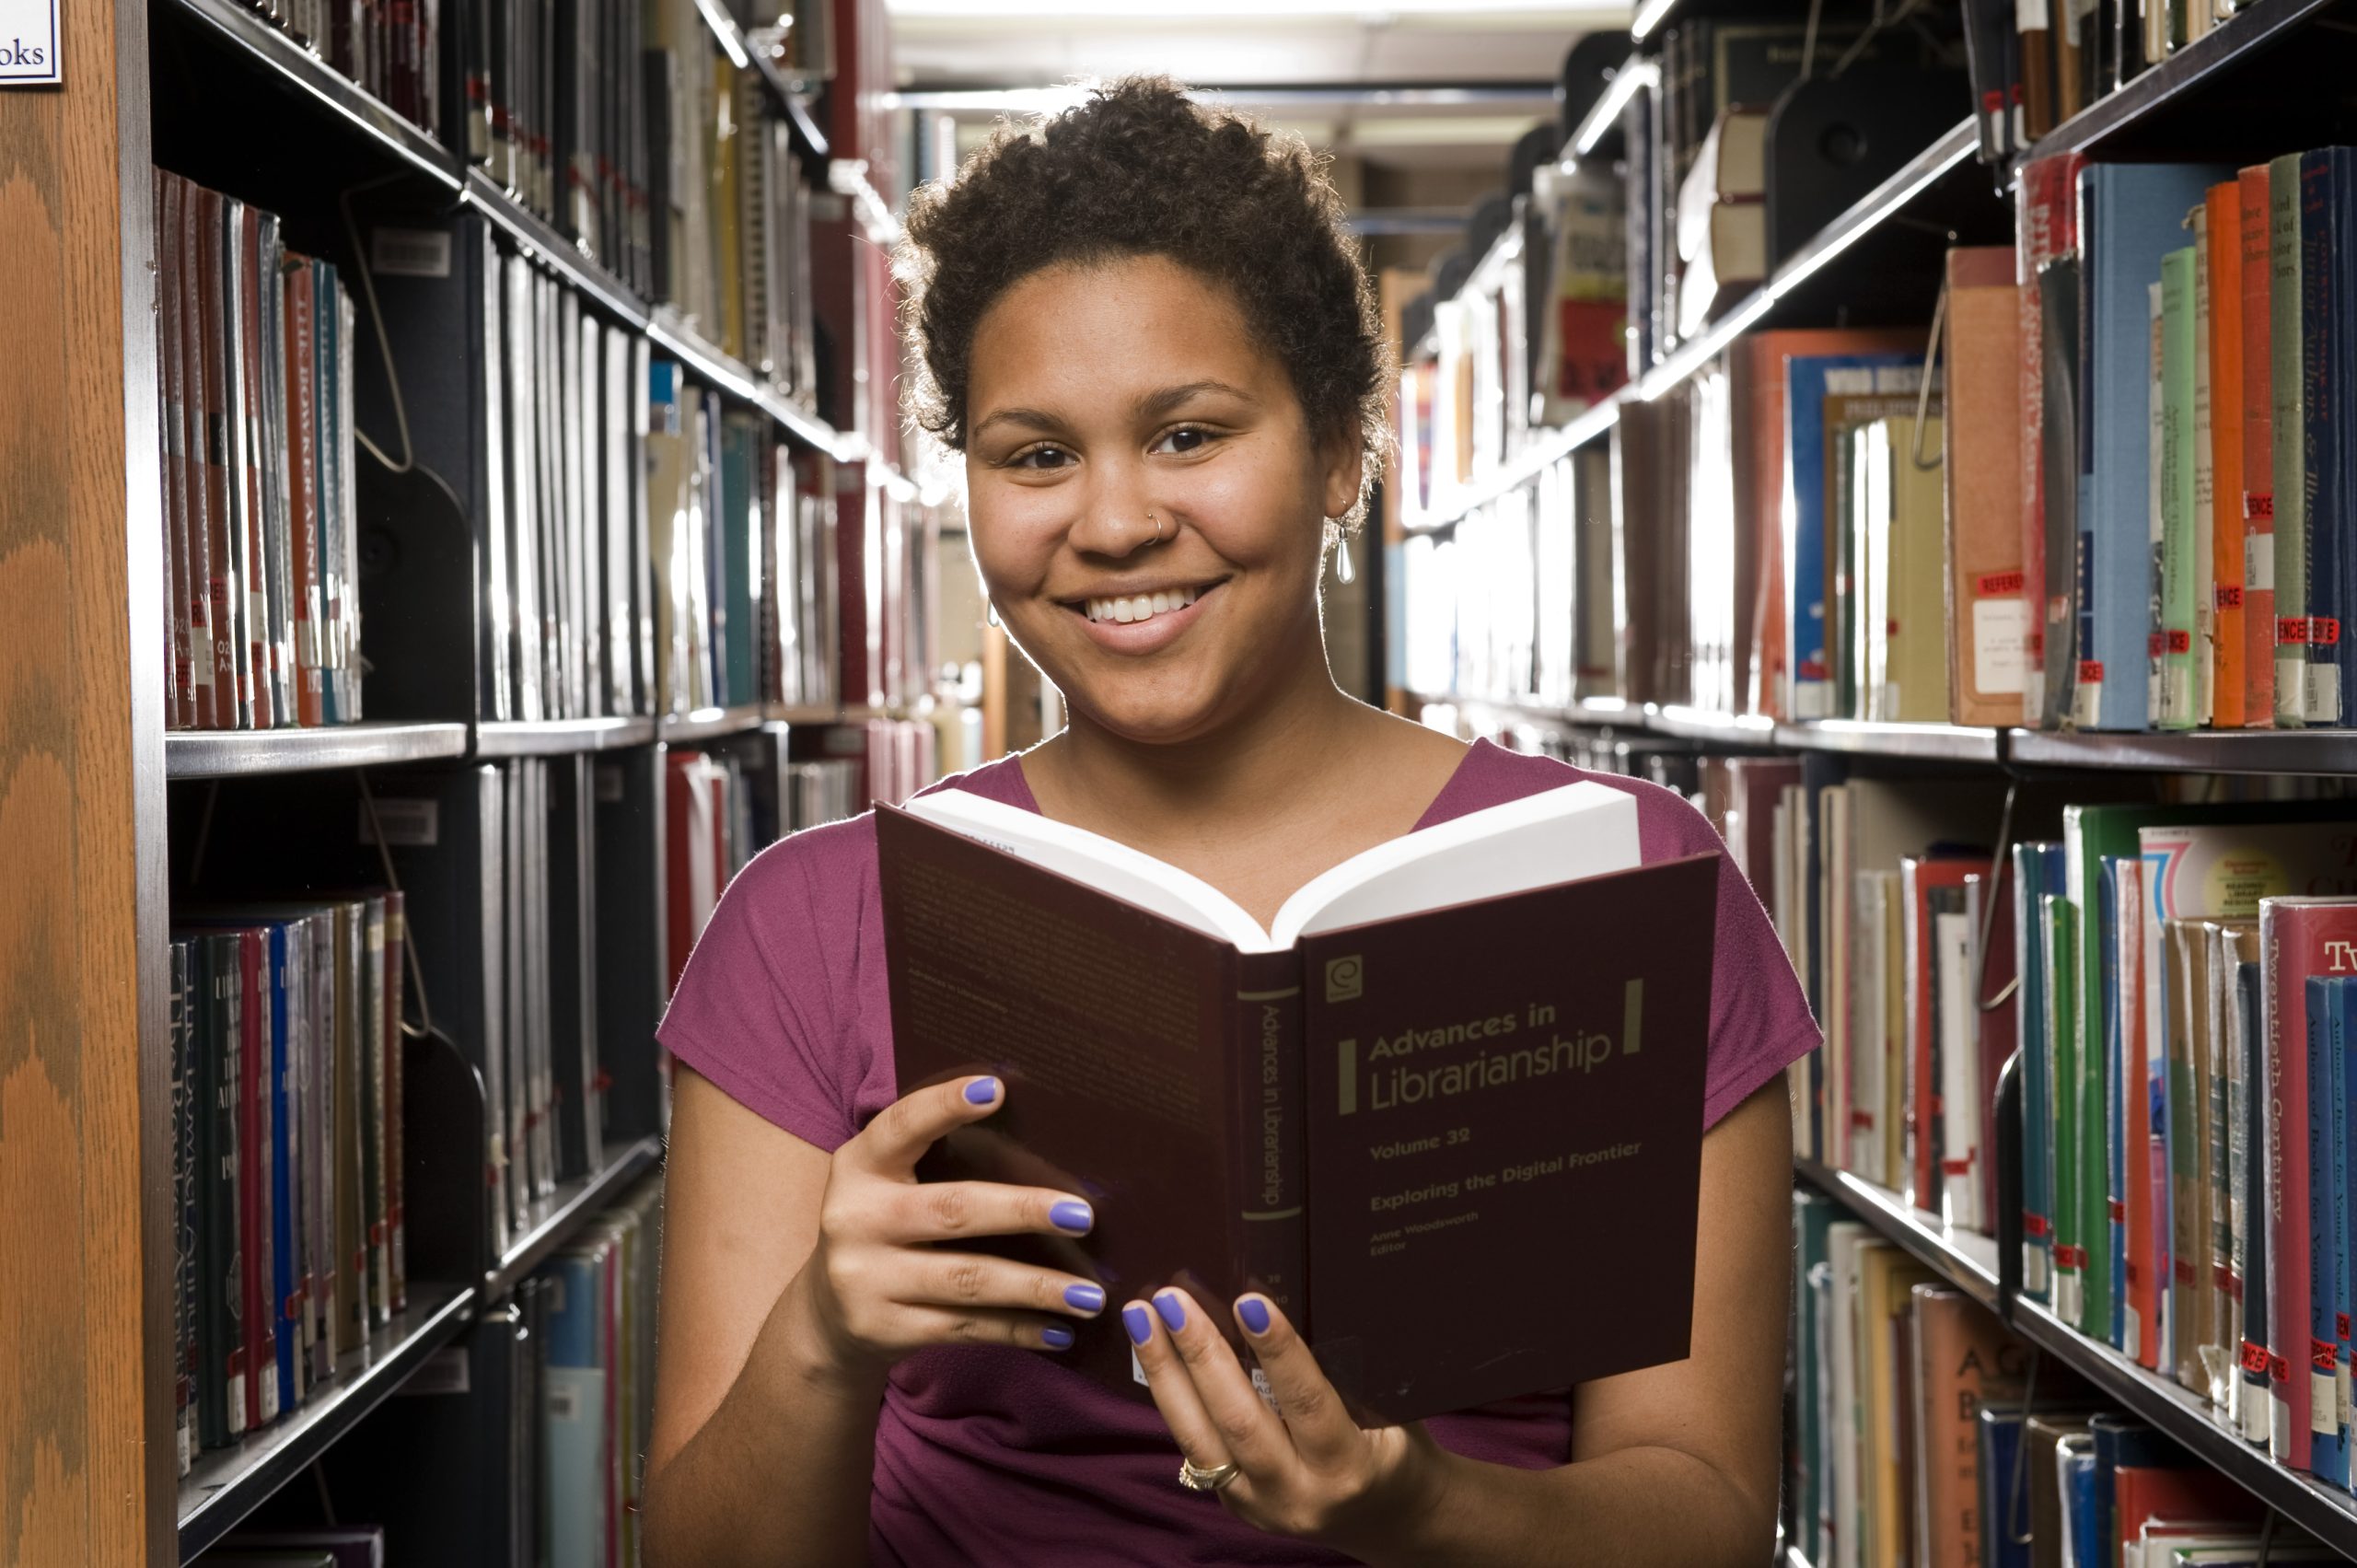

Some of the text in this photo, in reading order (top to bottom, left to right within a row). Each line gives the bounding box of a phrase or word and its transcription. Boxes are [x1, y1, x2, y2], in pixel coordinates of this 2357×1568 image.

[2303, 238, 2319, 606] Junior Authors & Illustrators
[170, 972, 182, 1069] The
[1369, 1003, 1556, 1062] Advances in
[2309, 1014, 2319, 1092] Authors
[1371, 1028, 1611, 1110] Librarianship
[2269, 937, 2283, 1223] Twentieth Century
[1261, 1005, 1283, 1205] Advances in Librarianship
[2311, 1099, 2320, 1122] of
[170, 1079, 183, 1233] Bowker
[1370, 1126, 1471, 1160] Volume 32
[1370, 1142, 1643, 1212] Exploring the Digital Frontier
[2311, 1128, 2320, 1187] Books
[2333, 1016, 2345, 1305] Authors of Books for Young People
[1370, 1211, 1480, 1243] Anne Woodsworth
[2311, 1195, 2321, 1224] for
[1370, 1241, 1407, 1257] Editor
[2311, 1232, 2321, 1295] Young
